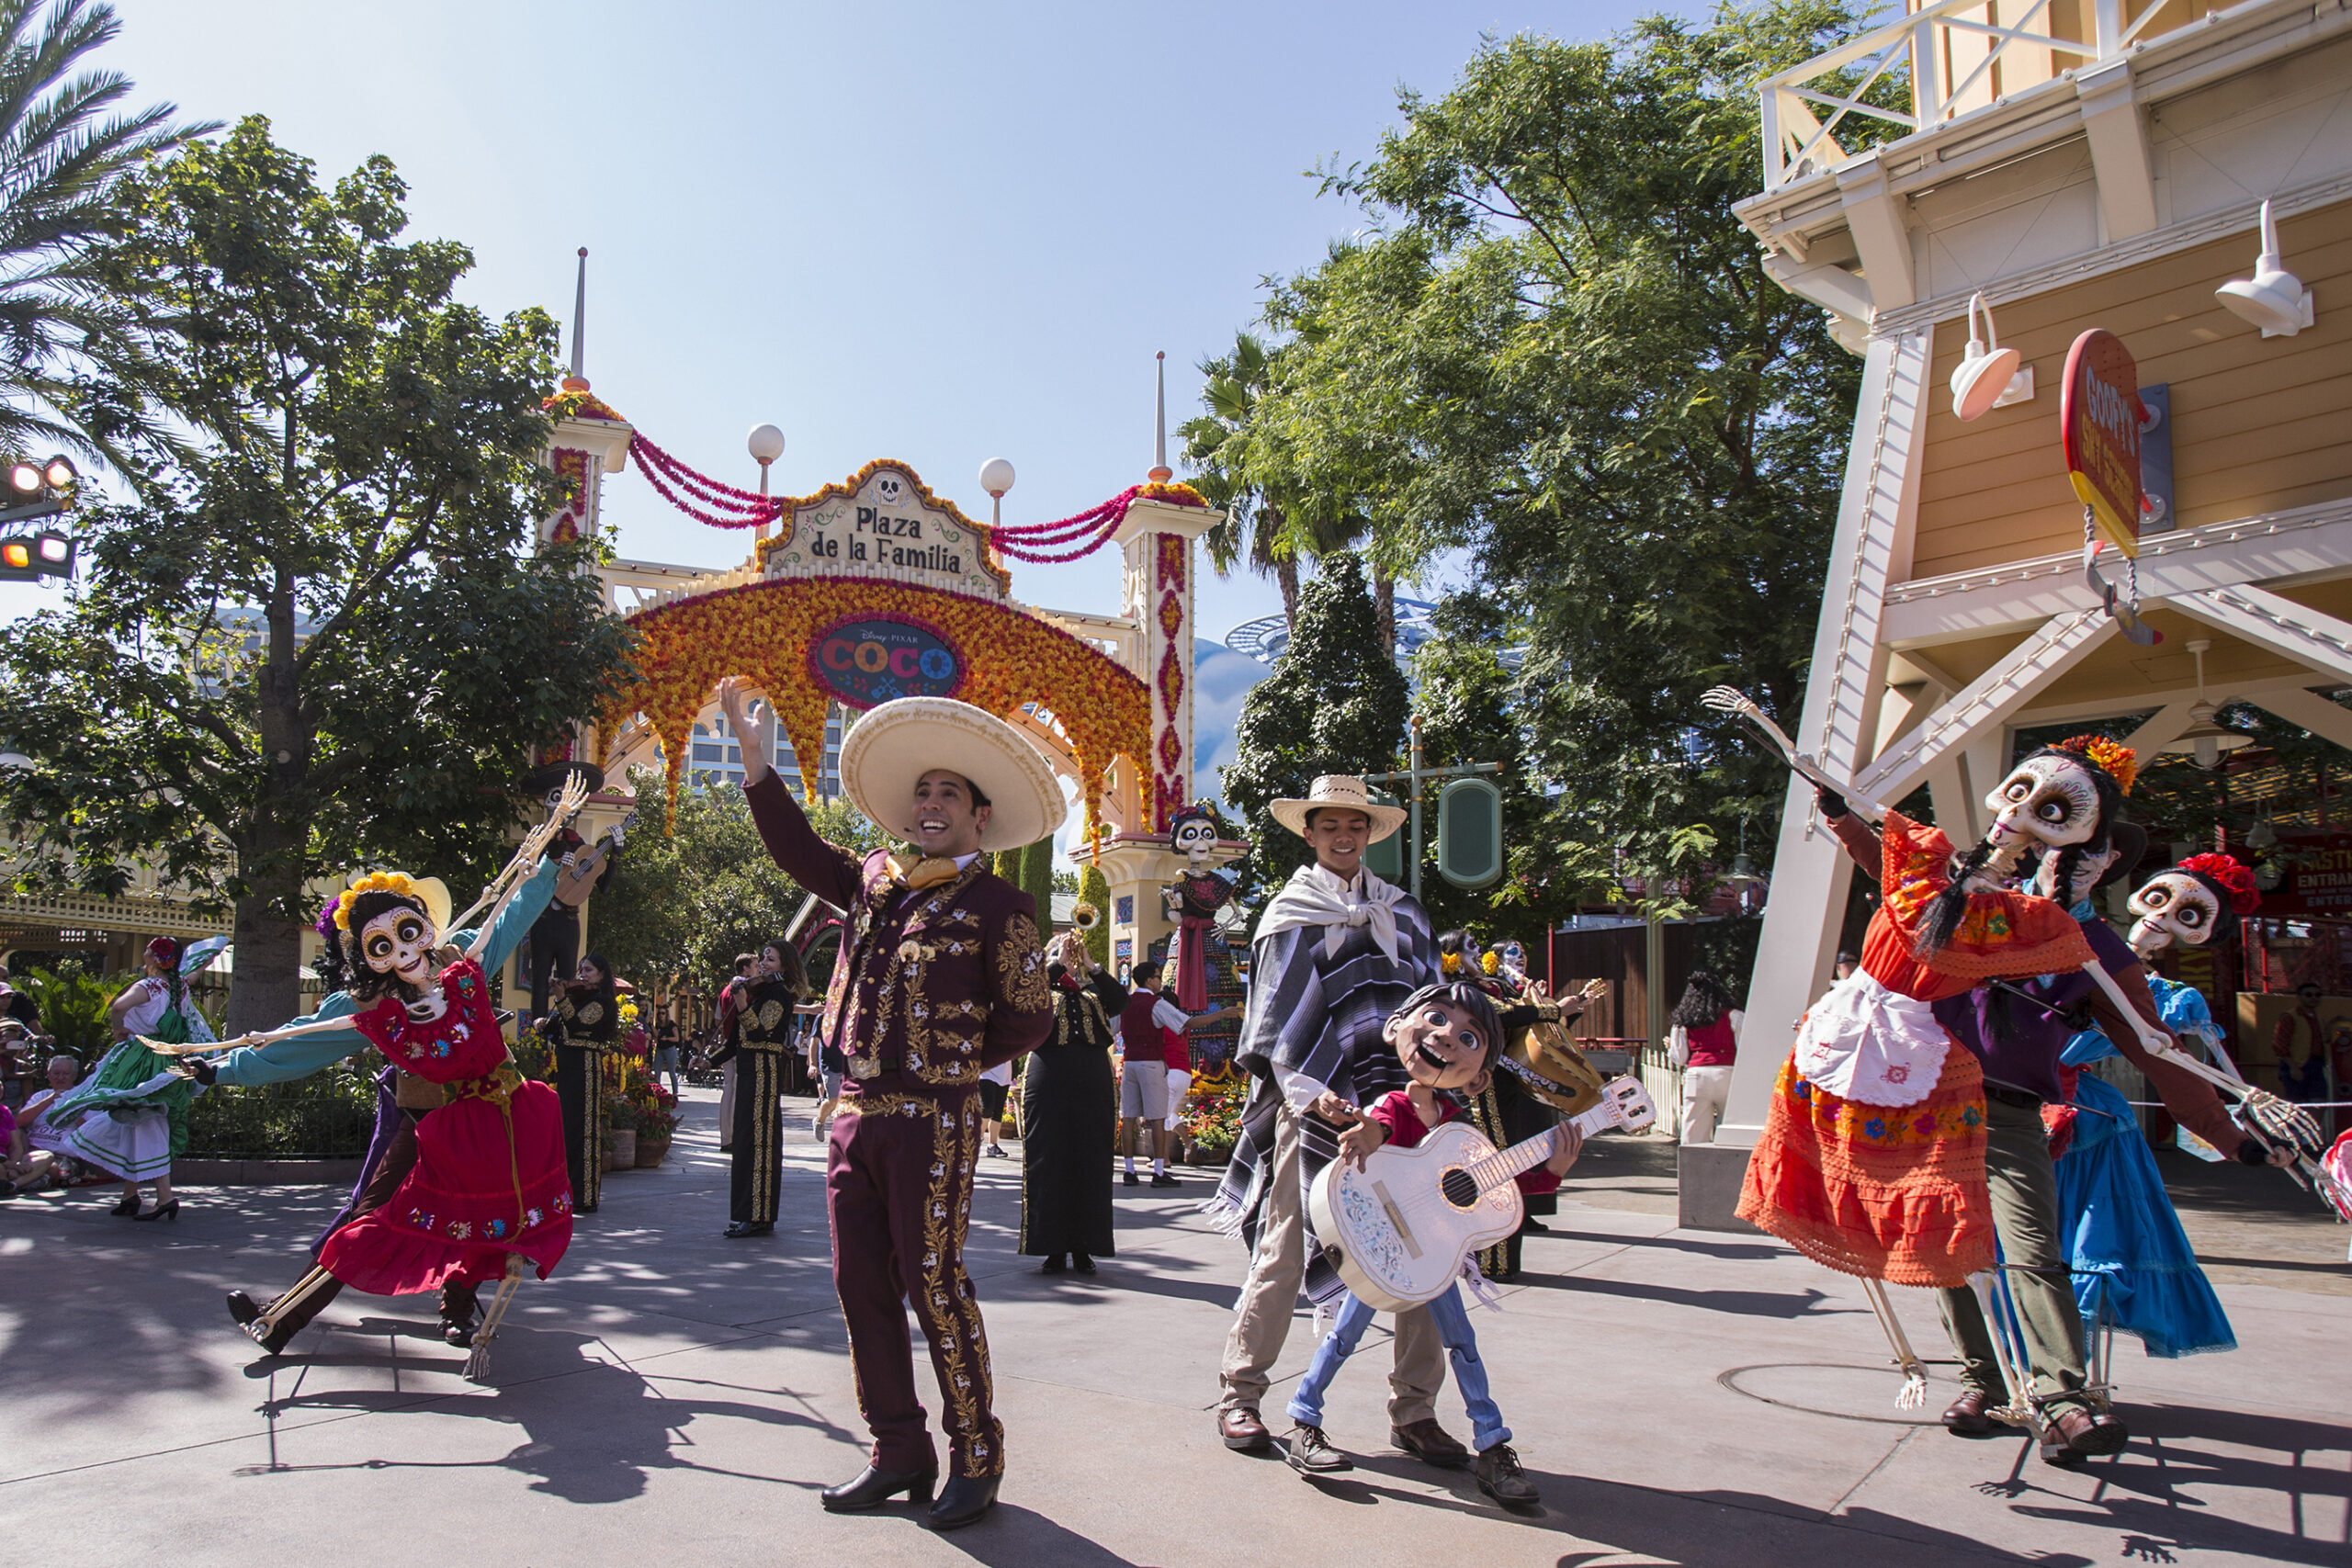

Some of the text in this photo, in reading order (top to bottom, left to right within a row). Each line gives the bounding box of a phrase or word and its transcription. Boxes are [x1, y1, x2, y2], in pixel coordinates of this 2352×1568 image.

[2086, 365, 2135, 457] GOOFY'S
[856, 506, 922, 539] Plaza
[811, 531, 962, 574] de la Familia
[860, 628, 918, 644] Disney PIXAR
[821, 637, 953, 680] COCO
